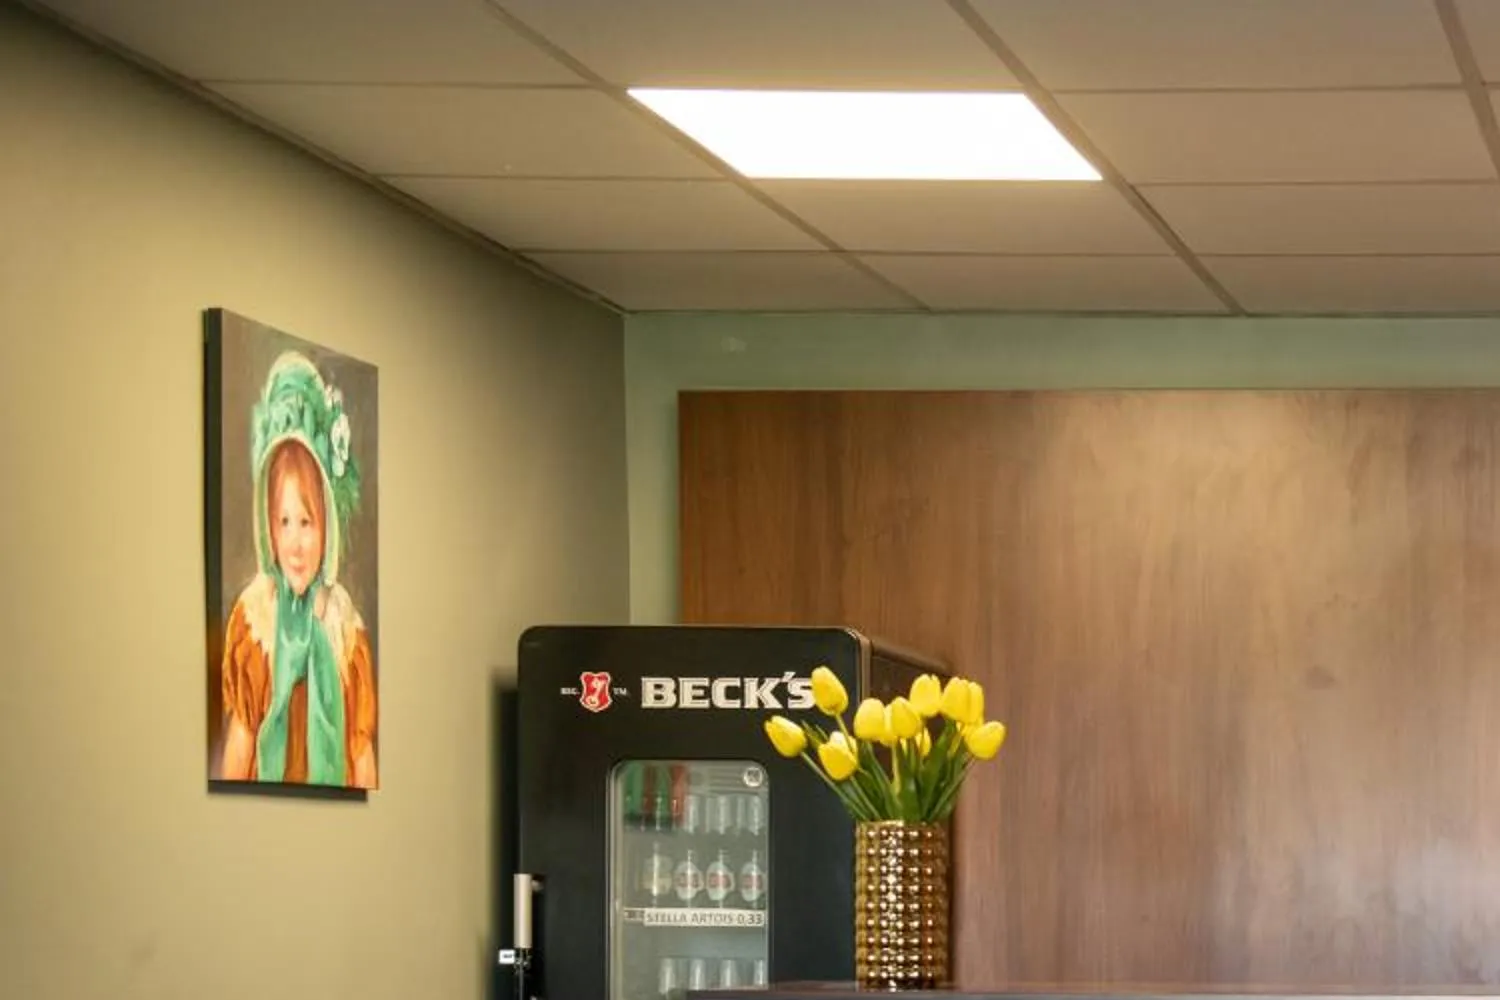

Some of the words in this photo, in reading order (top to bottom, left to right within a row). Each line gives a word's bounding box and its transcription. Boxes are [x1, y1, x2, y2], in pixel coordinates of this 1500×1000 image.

[641, 671, 817, 709] BECK'S
[646, 912, 688, 923] STELLA
[690, 912, 734, 924] ARTOIS
